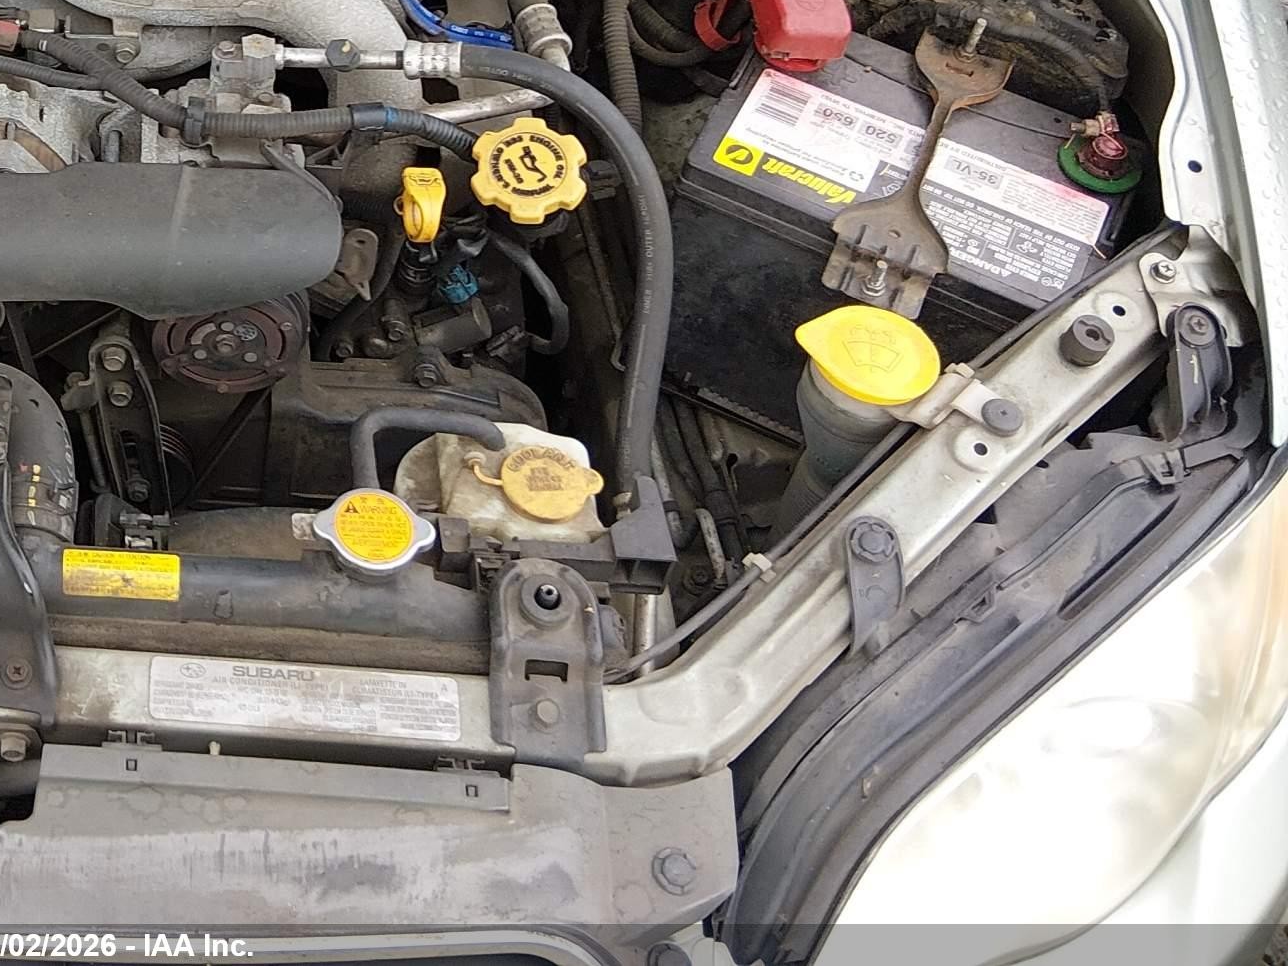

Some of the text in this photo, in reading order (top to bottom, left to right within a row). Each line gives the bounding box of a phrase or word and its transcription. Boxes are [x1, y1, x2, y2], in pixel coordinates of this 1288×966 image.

[822, 107, 854, 127] 650
[865, 124, 897, 144] 520
[530, 135, 564, 179] ENGINE OIL
[762, 157, 856, 204] Valucraft
[951, 160, 998, 184] 35-VL
[645, 228, 653, 257] OUTER
[232, 665, 314, 682] SUBARU
